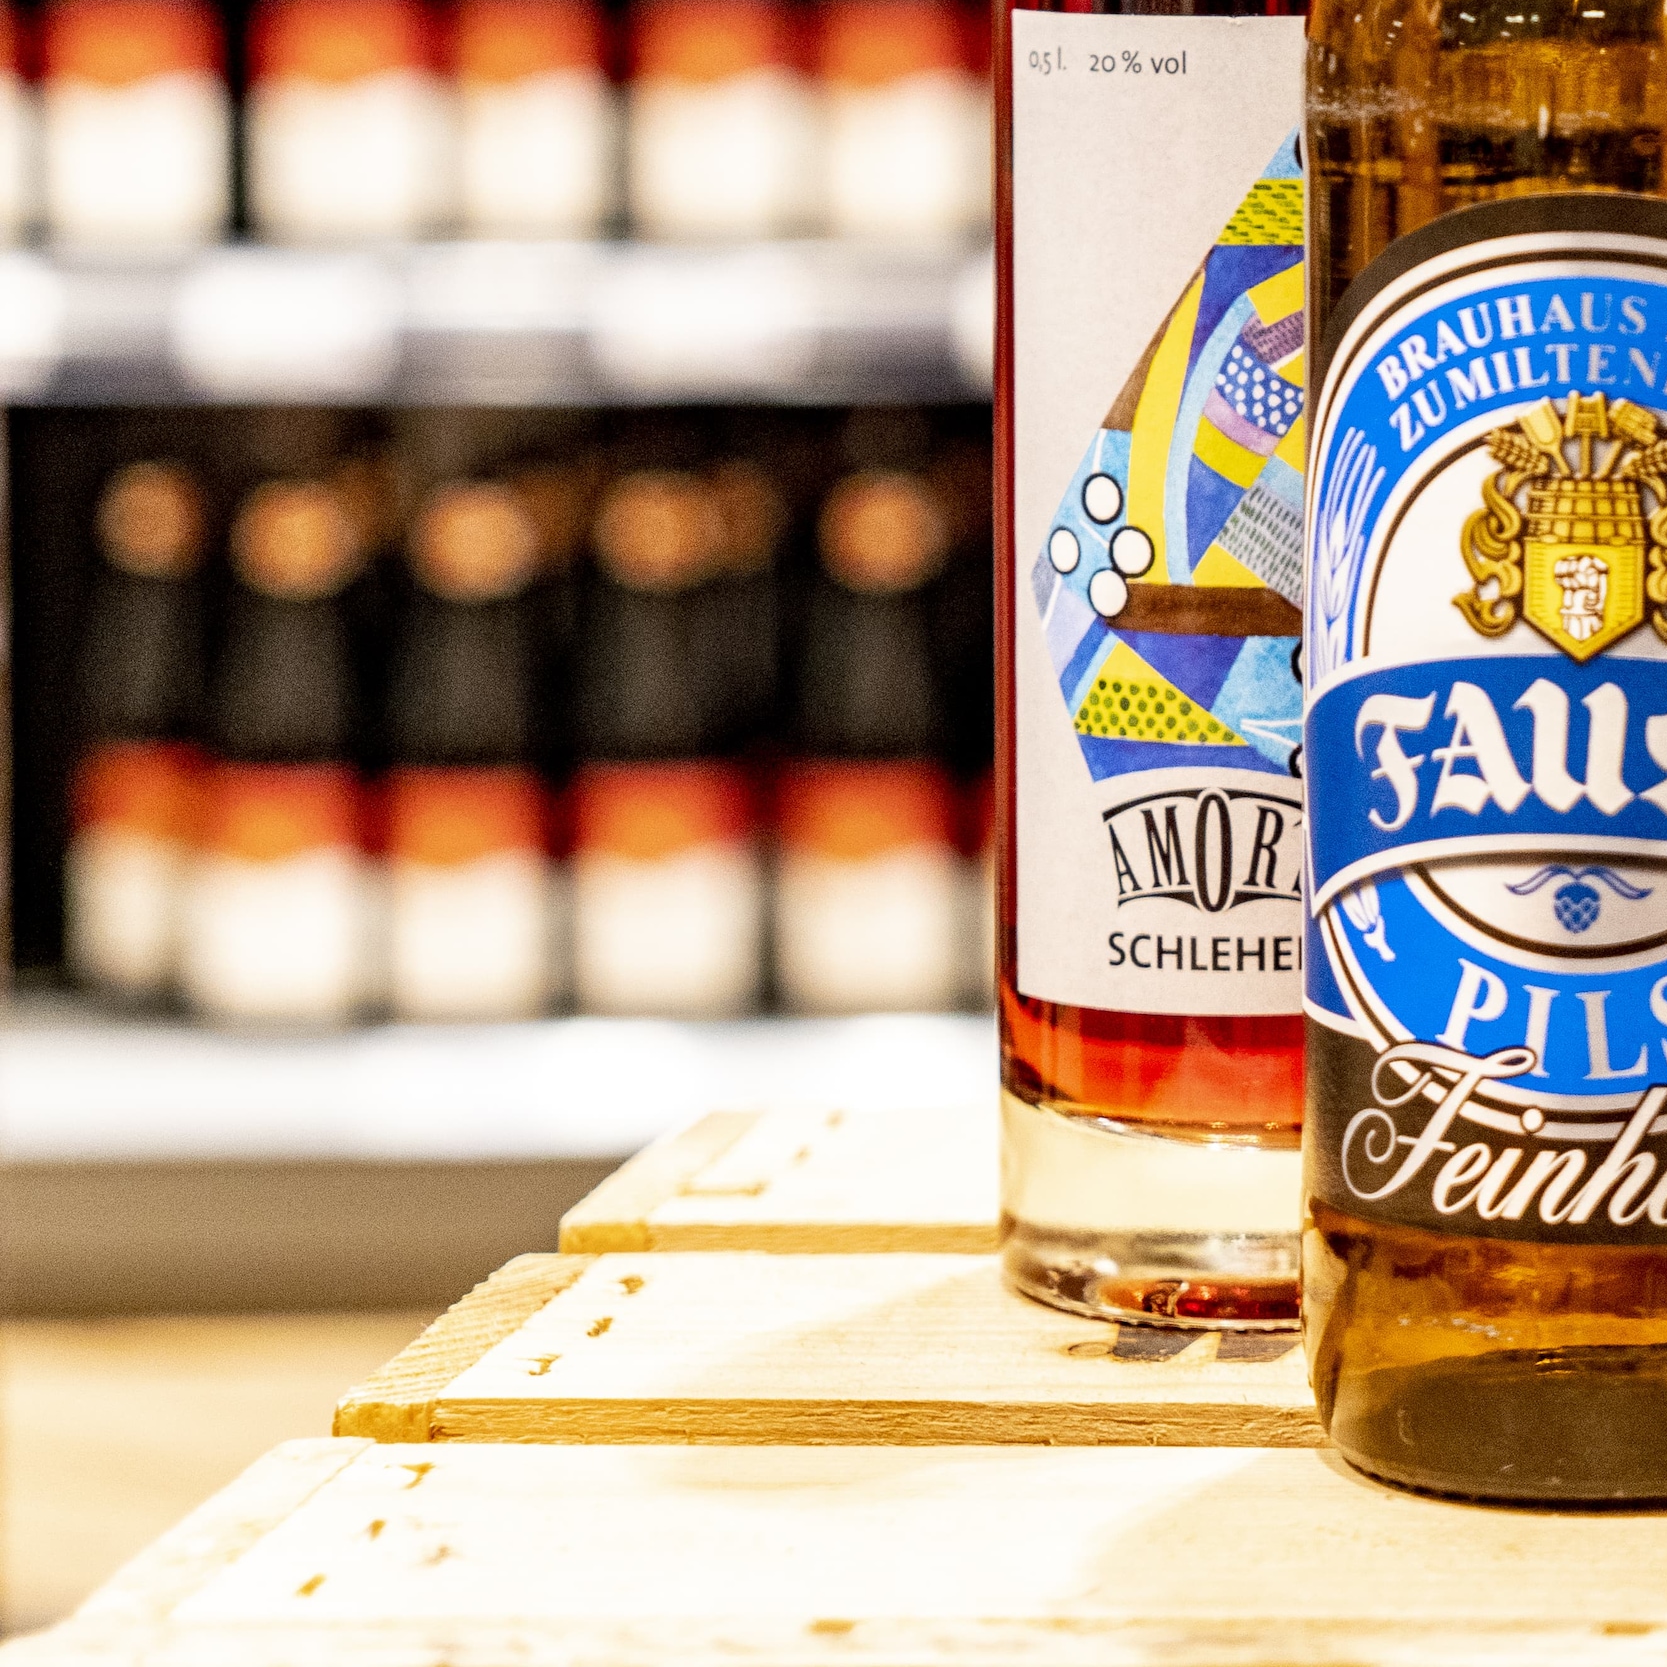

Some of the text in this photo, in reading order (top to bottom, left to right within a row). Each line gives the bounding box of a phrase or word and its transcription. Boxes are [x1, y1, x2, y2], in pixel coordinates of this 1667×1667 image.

[1090, 53, 1115, 72] 20
[1121, 50, 1142, 74] %
[1151, 50, 1187, 75] vol
[1376, 291, 1648, 402] BRAUHAUS
[1109, 792, 1302, 913] AMOR
[1108, 932, 1302, 971] SCHLEHE
